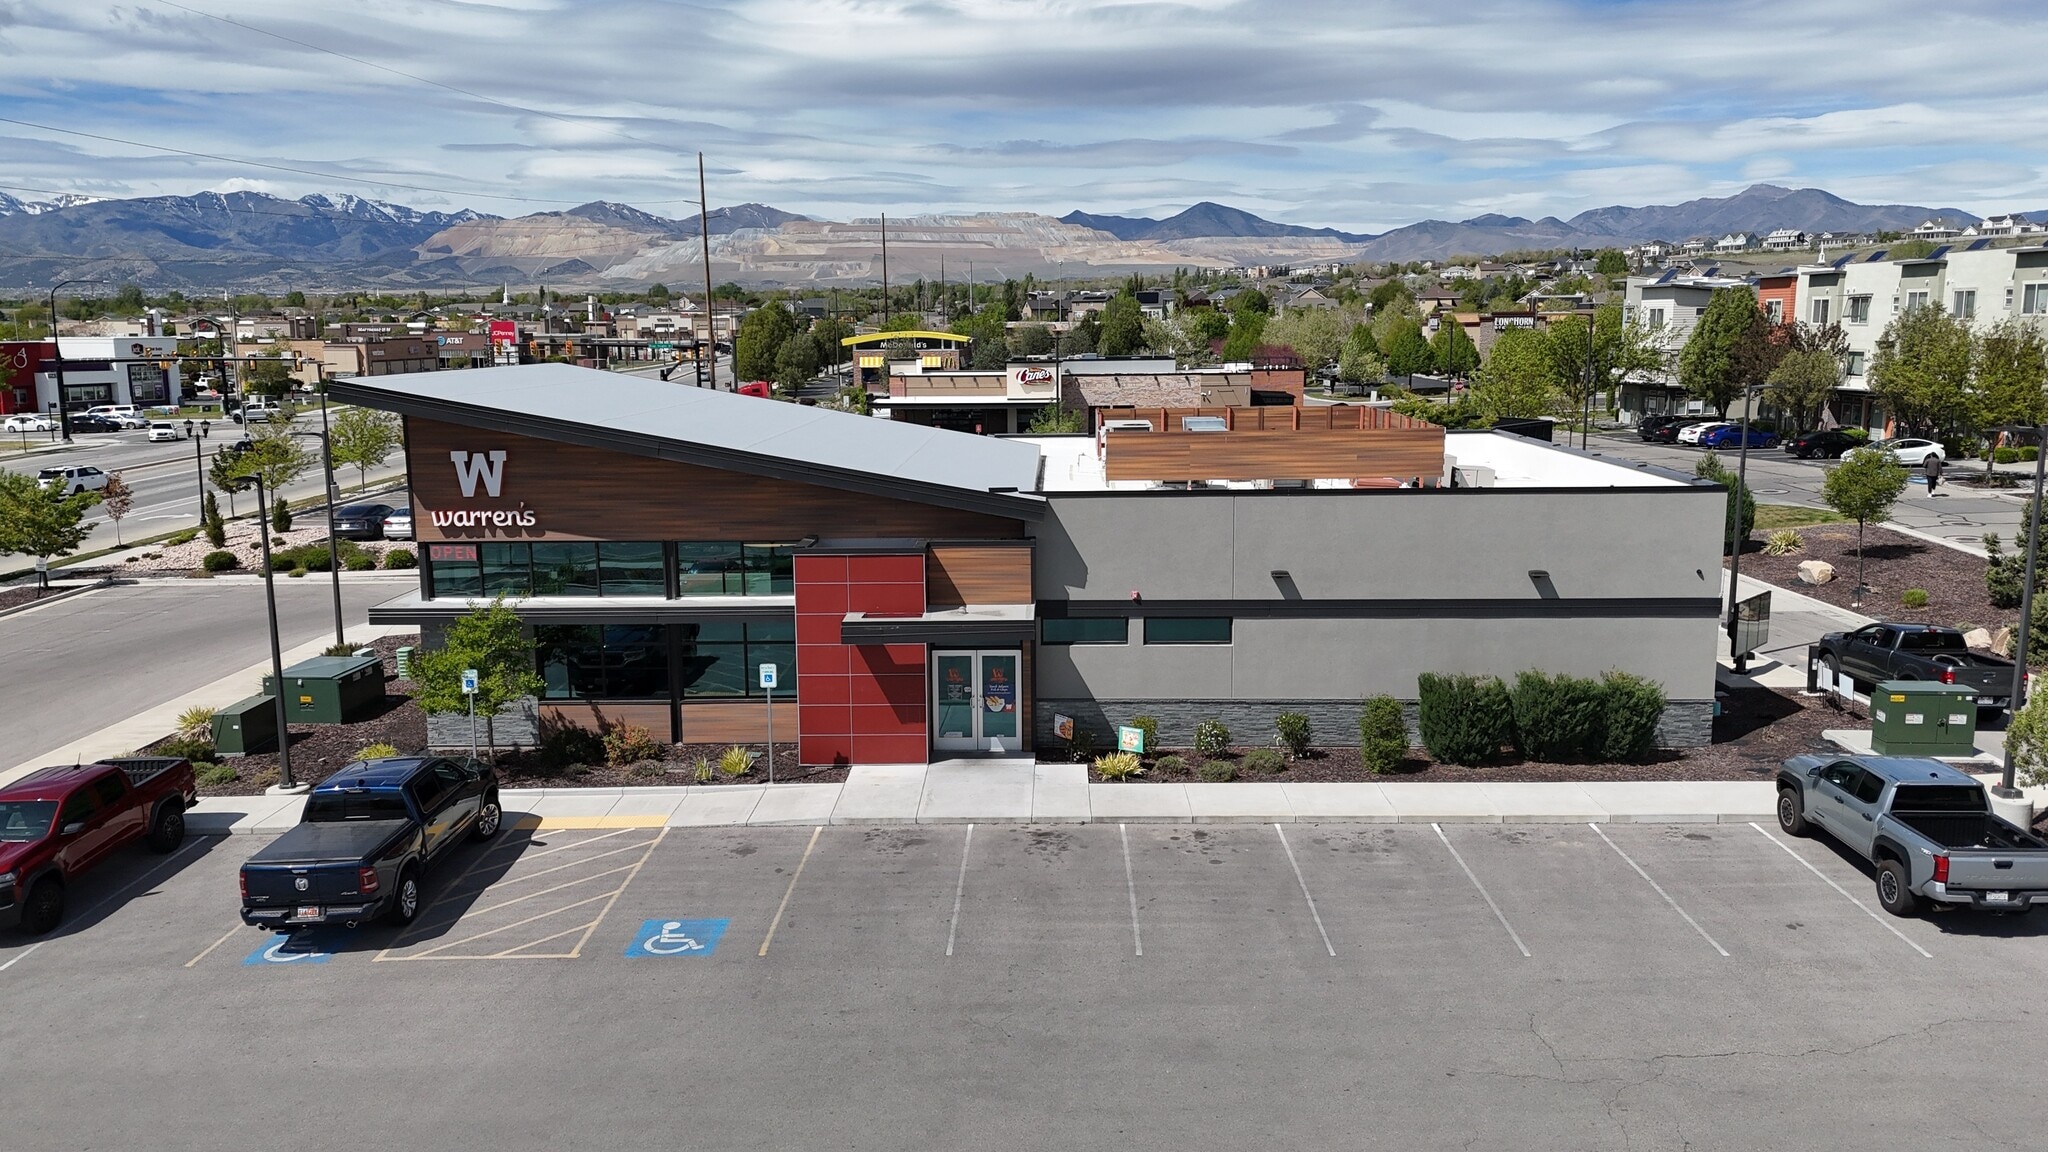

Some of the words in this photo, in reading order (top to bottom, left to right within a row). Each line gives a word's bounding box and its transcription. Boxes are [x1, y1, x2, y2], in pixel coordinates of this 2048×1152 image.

[446, 337, 464, 345] AT&T
[880, 341, 927, 349] McDold's
[450, 450, 507, 497] W
[431, 501, 536, 527] warren's
[431, 546, 476, 559] OPEN
